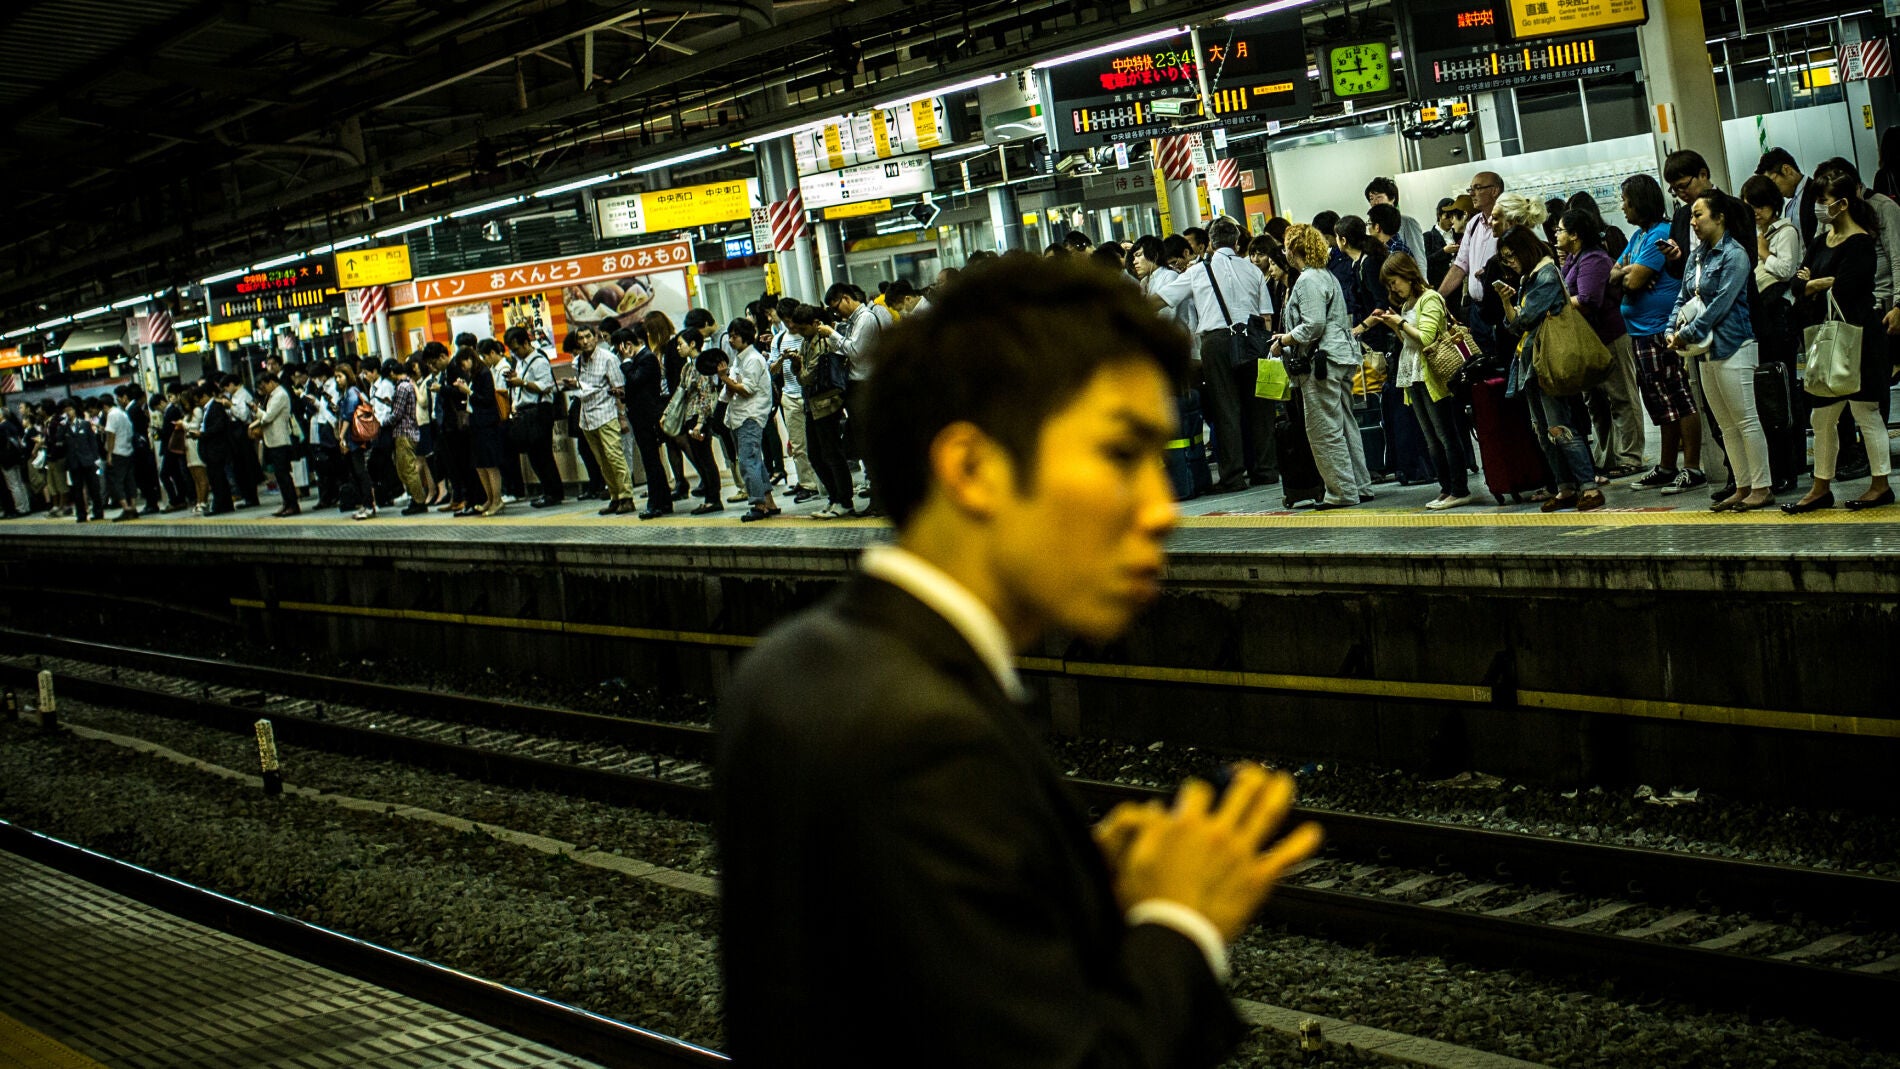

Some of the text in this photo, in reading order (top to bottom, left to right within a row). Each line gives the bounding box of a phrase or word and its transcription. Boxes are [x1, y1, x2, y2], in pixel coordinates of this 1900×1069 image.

[1525, 3, 1549, 17] 直進
[1521, 16, 1556, 27] Go straight
[1112, 54, 1154, 74] 中央特快
[657, 185, 741, 204] 中央西口 中央東口
[744, 239, 753, 255] 9
[423, 280, 465, 298] パン
[489, 260, 582, 290] おべんとう
[601, 245, 688, 273] おのみもの
